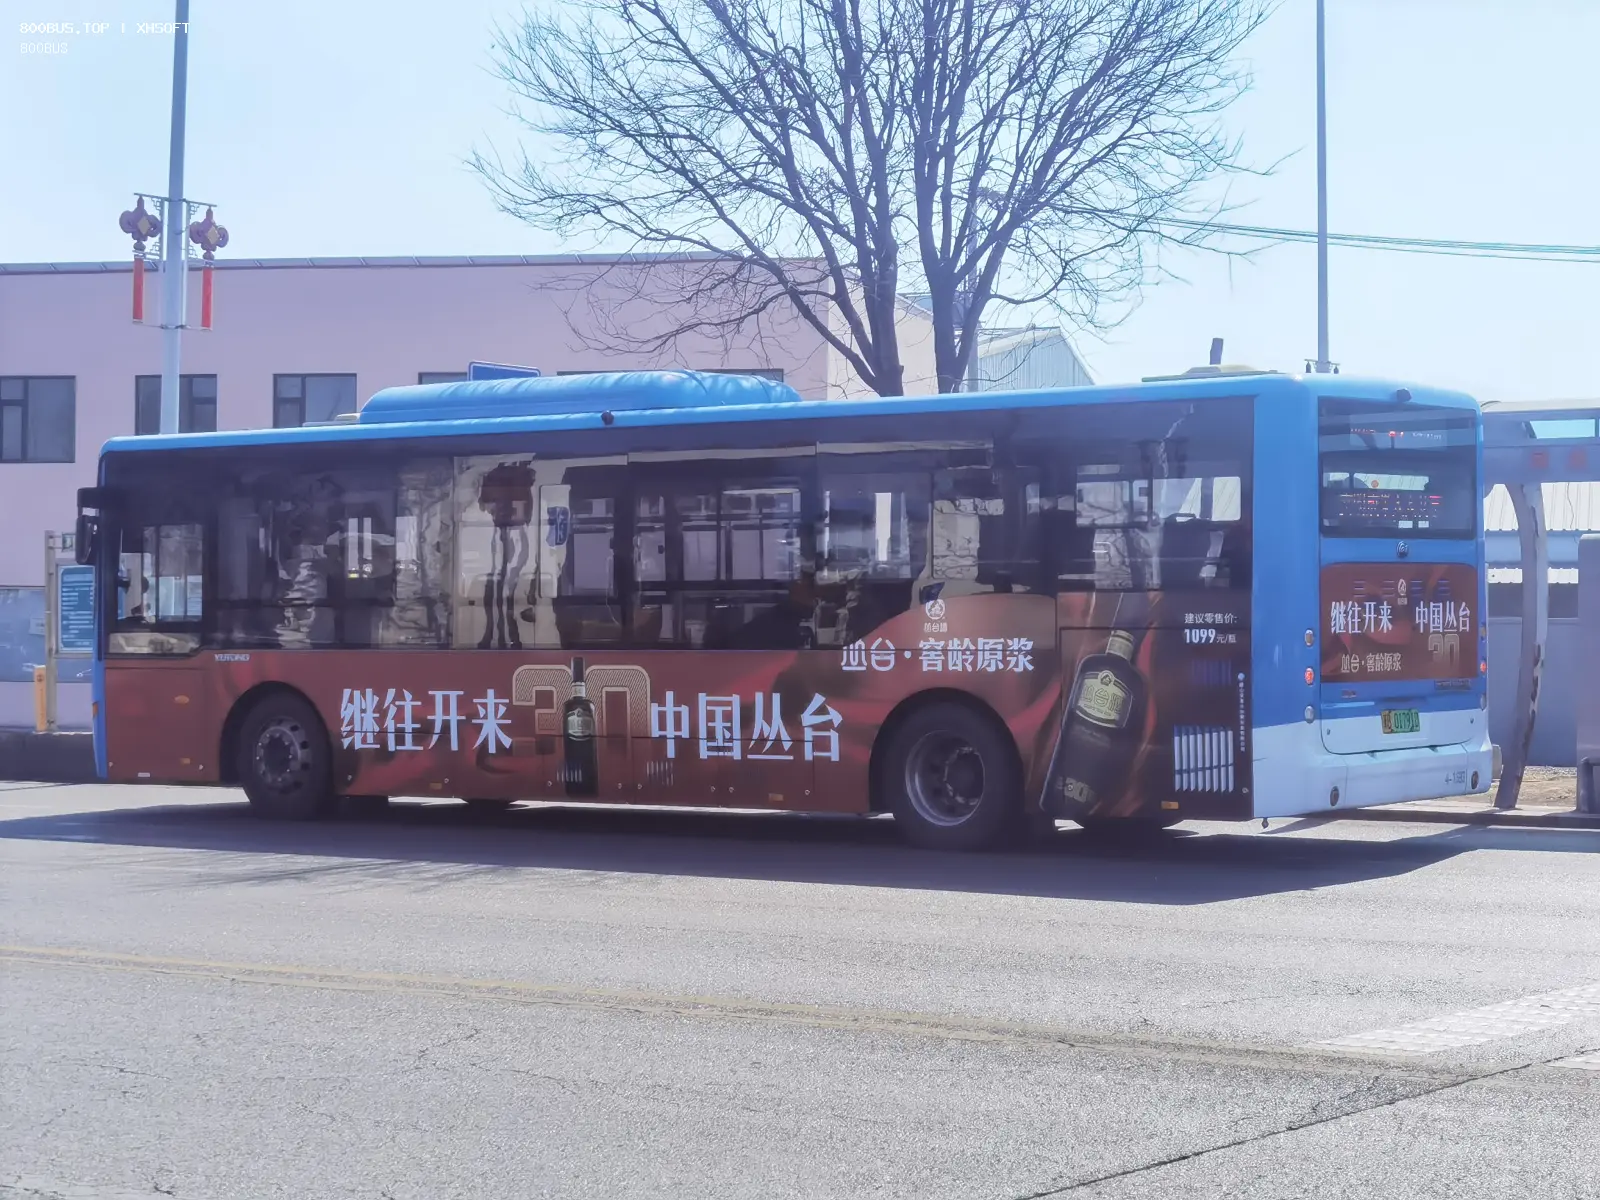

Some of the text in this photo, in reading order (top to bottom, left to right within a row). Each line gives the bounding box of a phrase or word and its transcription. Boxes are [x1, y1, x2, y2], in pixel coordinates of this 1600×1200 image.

[1331, 600, 1471, 634] 继往开来 中国丛台
[340, 688, 513, 754] 继往开来
[650, 690, 843, 762] 中国丛台
